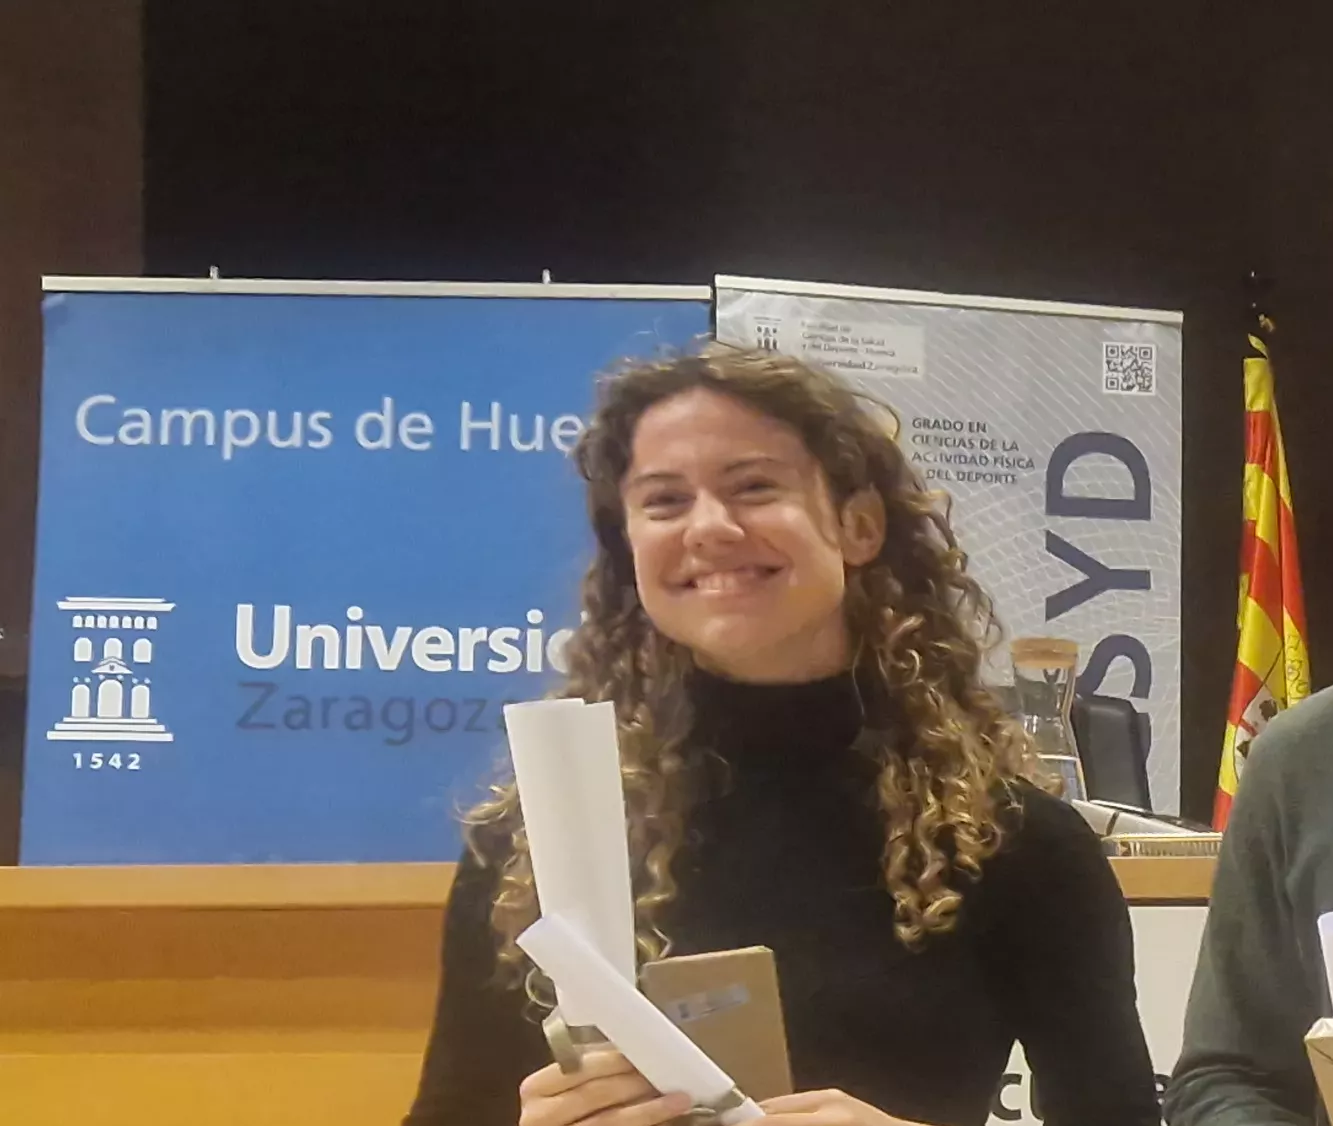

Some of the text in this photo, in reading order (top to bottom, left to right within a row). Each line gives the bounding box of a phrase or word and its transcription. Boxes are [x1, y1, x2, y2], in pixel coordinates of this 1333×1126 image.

[75, 394, 588, 460] Campus de Hue
[911, 417, 987, 433] GRADO EN
[911, 434, 975, 449] CIENCIAS
[1002, 441, 1020, 452] LA
[236, 680, 510, 746] Zaragoz
[72, 752, 141, 770] 1542
